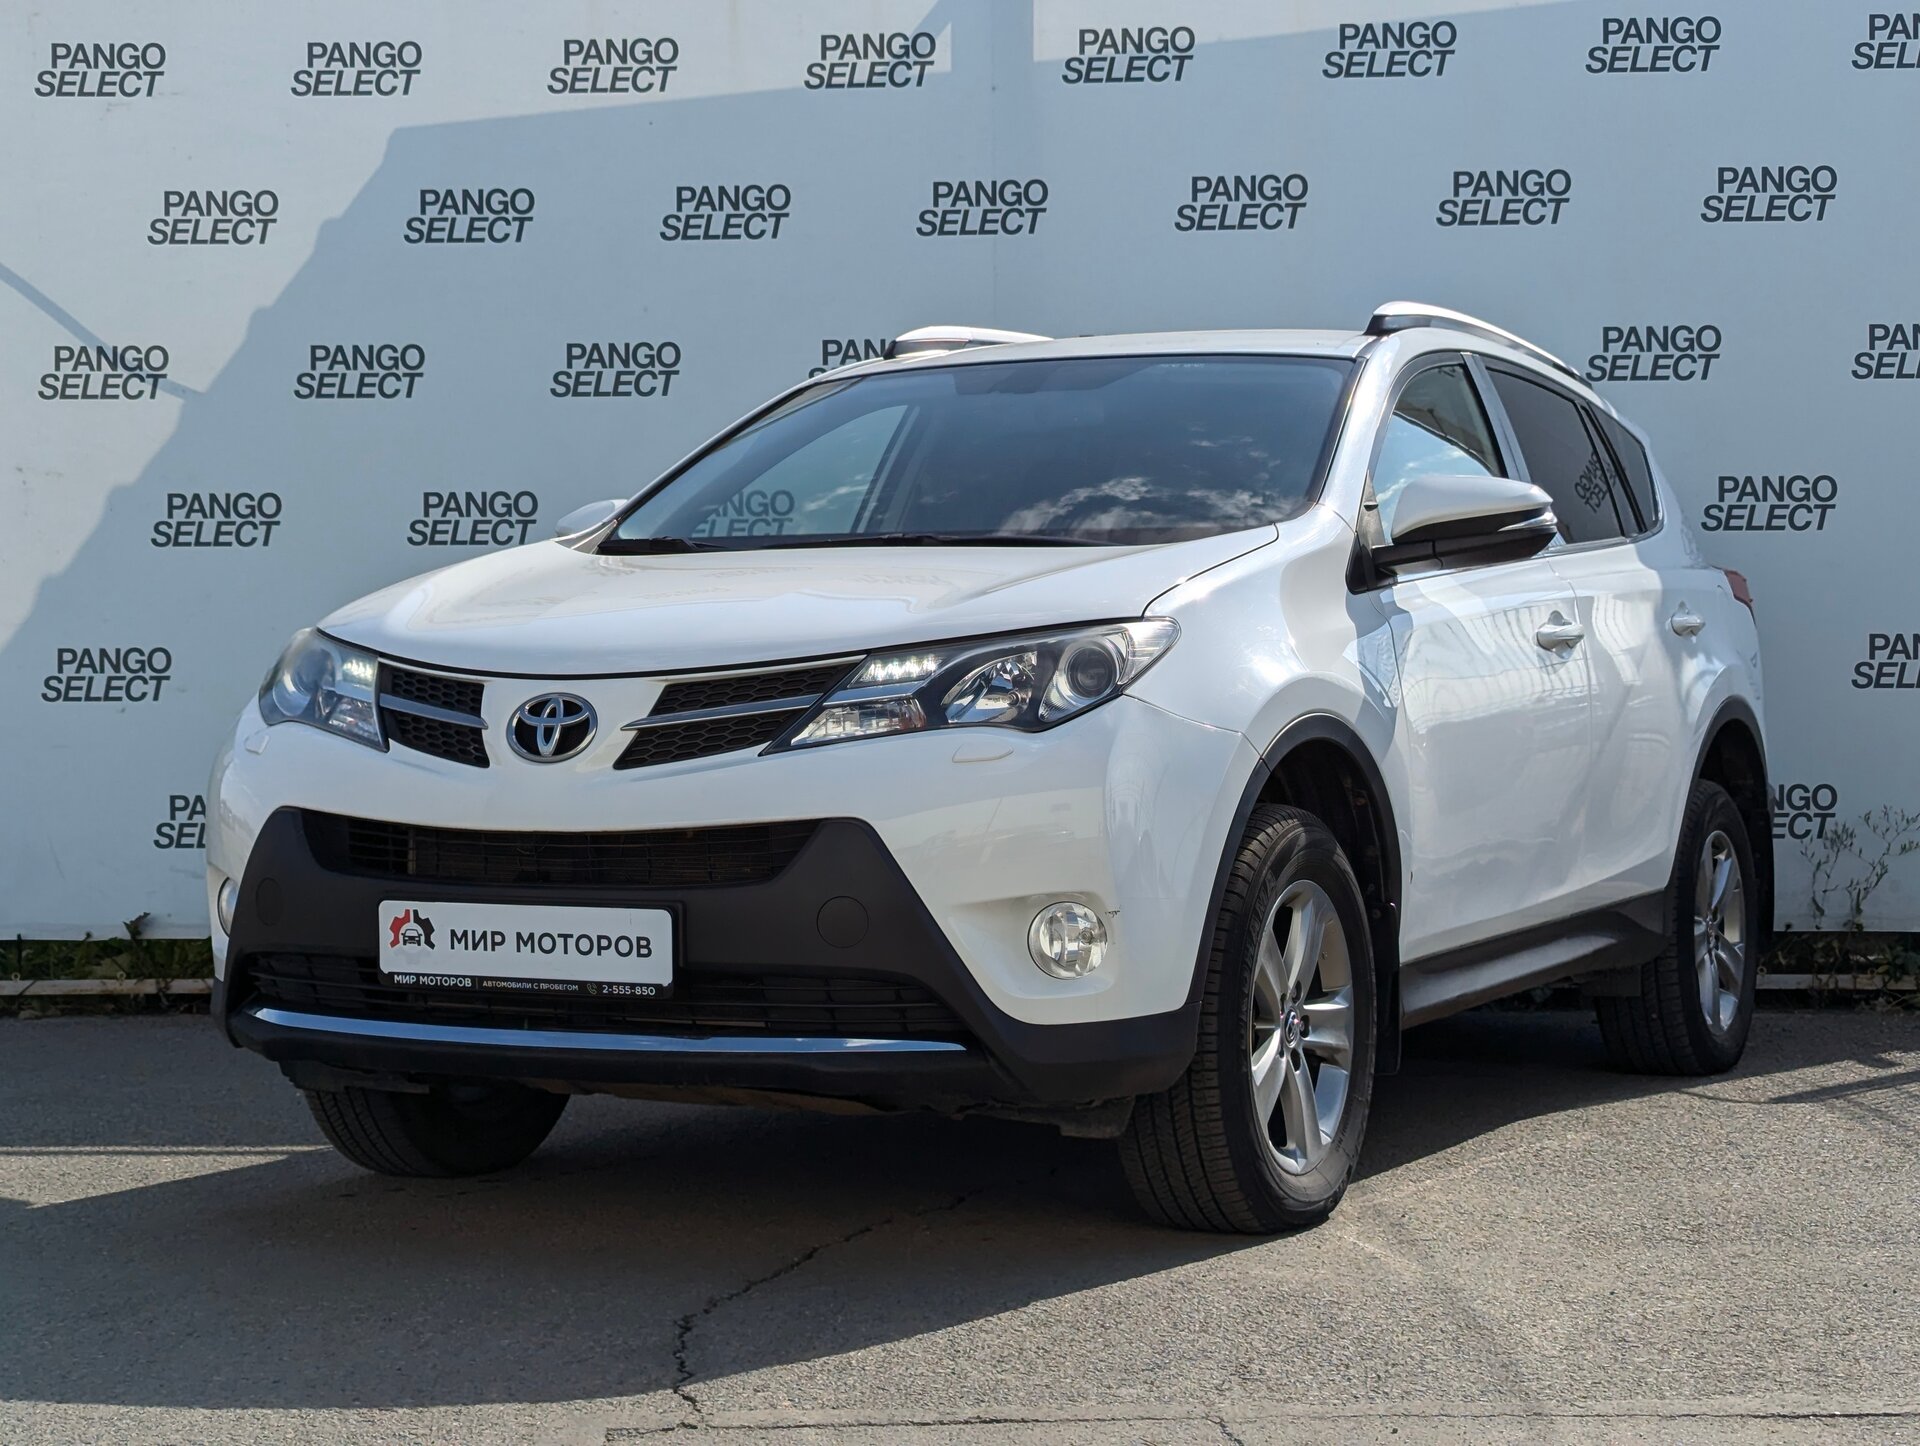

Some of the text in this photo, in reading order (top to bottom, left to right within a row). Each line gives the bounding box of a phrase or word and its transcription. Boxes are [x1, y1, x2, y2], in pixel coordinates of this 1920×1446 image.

[1079, 26, 1195, 55] PANGO
[1339, 20, 1457, 50] PANGO
[1602, 15, 1722, 45] PANGO
[51, 42, 166, 70] PANGO
[307, 41, 422, 69] PANGO
[564, 37, 679, 66] PANGO
[820, 31, 936, 61] PANGO
[1585, 44, 1721, 74] SELECT
[804, 60, 935, 90] SELECT
[1061, 54, 1194, 84] SELECT
[1322, 49, 1456, 79] SELECT
[34, 70, 165, 98] SELECT
[290, 69, 421, 97] SELECT
[547, 66, 678, 94] SELECT
[932, 178, 1049, 208] PANGO
[1191, 173, 1309, 203] PANGO
[1453, 168, 1572, 198] PANGO
[1717, 164, 1838, 194] PANGO
[164, 190, 279, 217] PANGO
[420, 187, 535, 216] PANGO
[676, 183, 791, 213] PANGO
[1435, 197, 1571, 227] SELECT
[1700, 193, 1836, 223] SELECT
[147, 218, 278, 245] SELECT
[403, 216, 534, 244] SELECT
[659, 212, 790, 242] SELECT
[915, 207, 1048, 237] SELECT
[1174, 202, 1307, 232] SELECT
[821, 338, 890, 366] PAN
[1602, 324, 1722, 354] PANGO
[54, 345, 169, 373] PANGO
[310, 343, 426, 372] PANGO
[566, 341, 682, 370] PANGO
[1585, 353, 1721, 382] SELECT
[38, 372, 168, 400] SELECT
[293, 371, 424, 400] SELECT
[549, 369, 680, 398] SELECT
[1717, 474, 1838, 503] PANGO
[167, 492, 283, 520] PANGO
[423, 490, 539, 519] PANGO
[1700, 503, 1837, 532] SELECT
[150, 520, 281, 548] SELECT
[406, 518, 538, 547] SELECT
[57, 646, 172, 675] PANGO
[41, 674, 172, 703] SELECT
[449, 928, 653, 958] МИР МОТОРОВ
[394, 974, 473, 988] МИР МОТОРОВ
[482, 980, 532, 990] АВТОМОБИЛИ
[540, 982, 579, 992] ПРОБЕГОМ
[602, 984, 656, 996] 2-555-850
